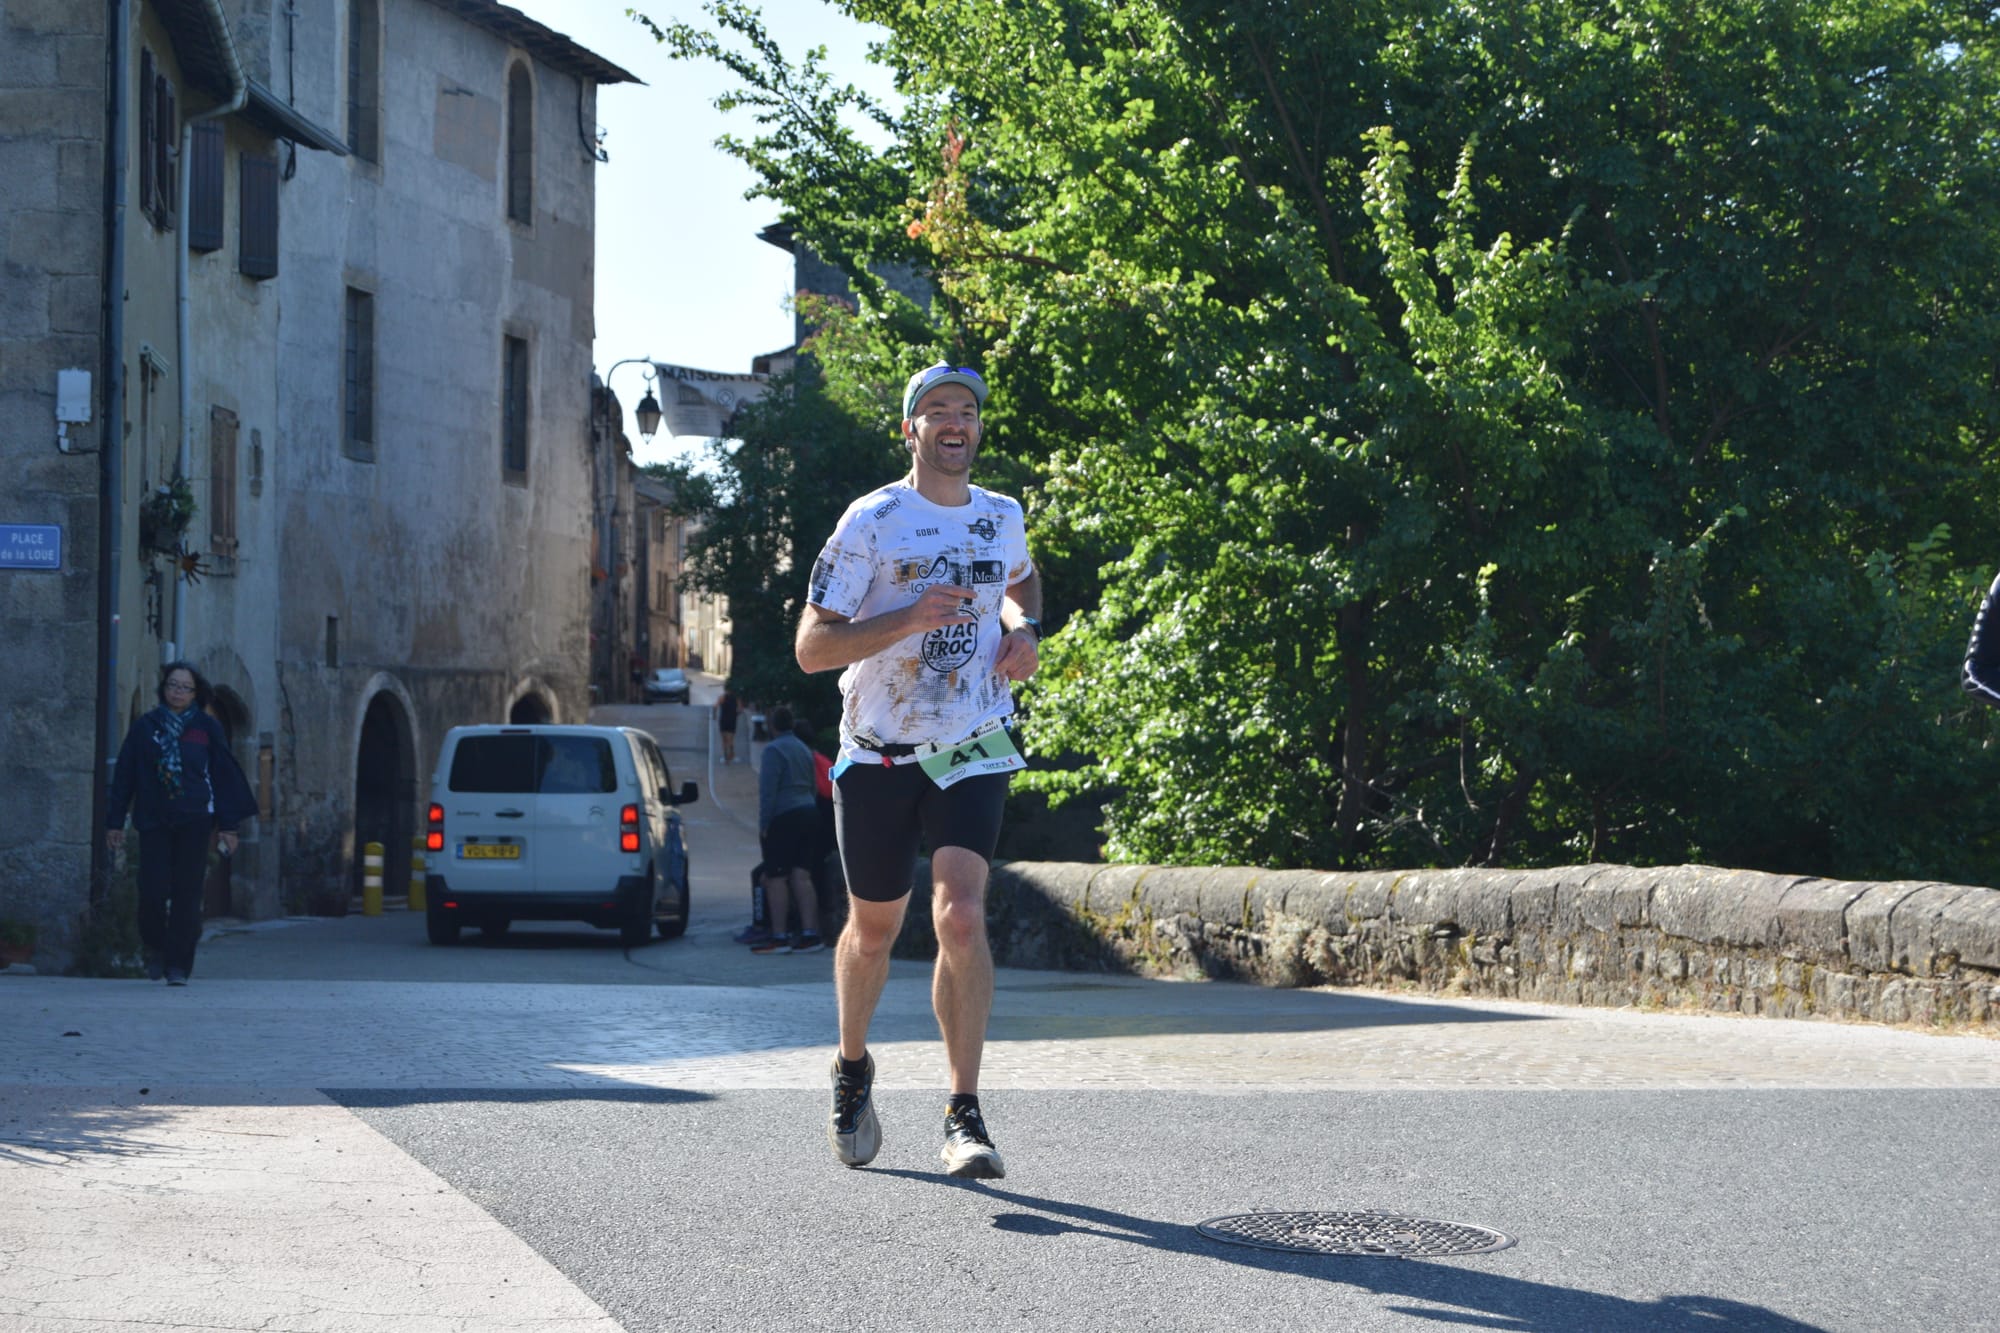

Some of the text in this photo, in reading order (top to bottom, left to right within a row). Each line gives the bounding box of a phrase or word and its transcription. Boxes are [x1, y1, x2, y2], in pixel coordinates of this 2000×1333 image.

[11, 532, 44, 545] PLACE
[915, 527, 940, 537] GOBIK
[1, 548, 55, 561] de la LOUE
[927, 639, 973, 656] TROC
[949, 742, 990, 767] 41
